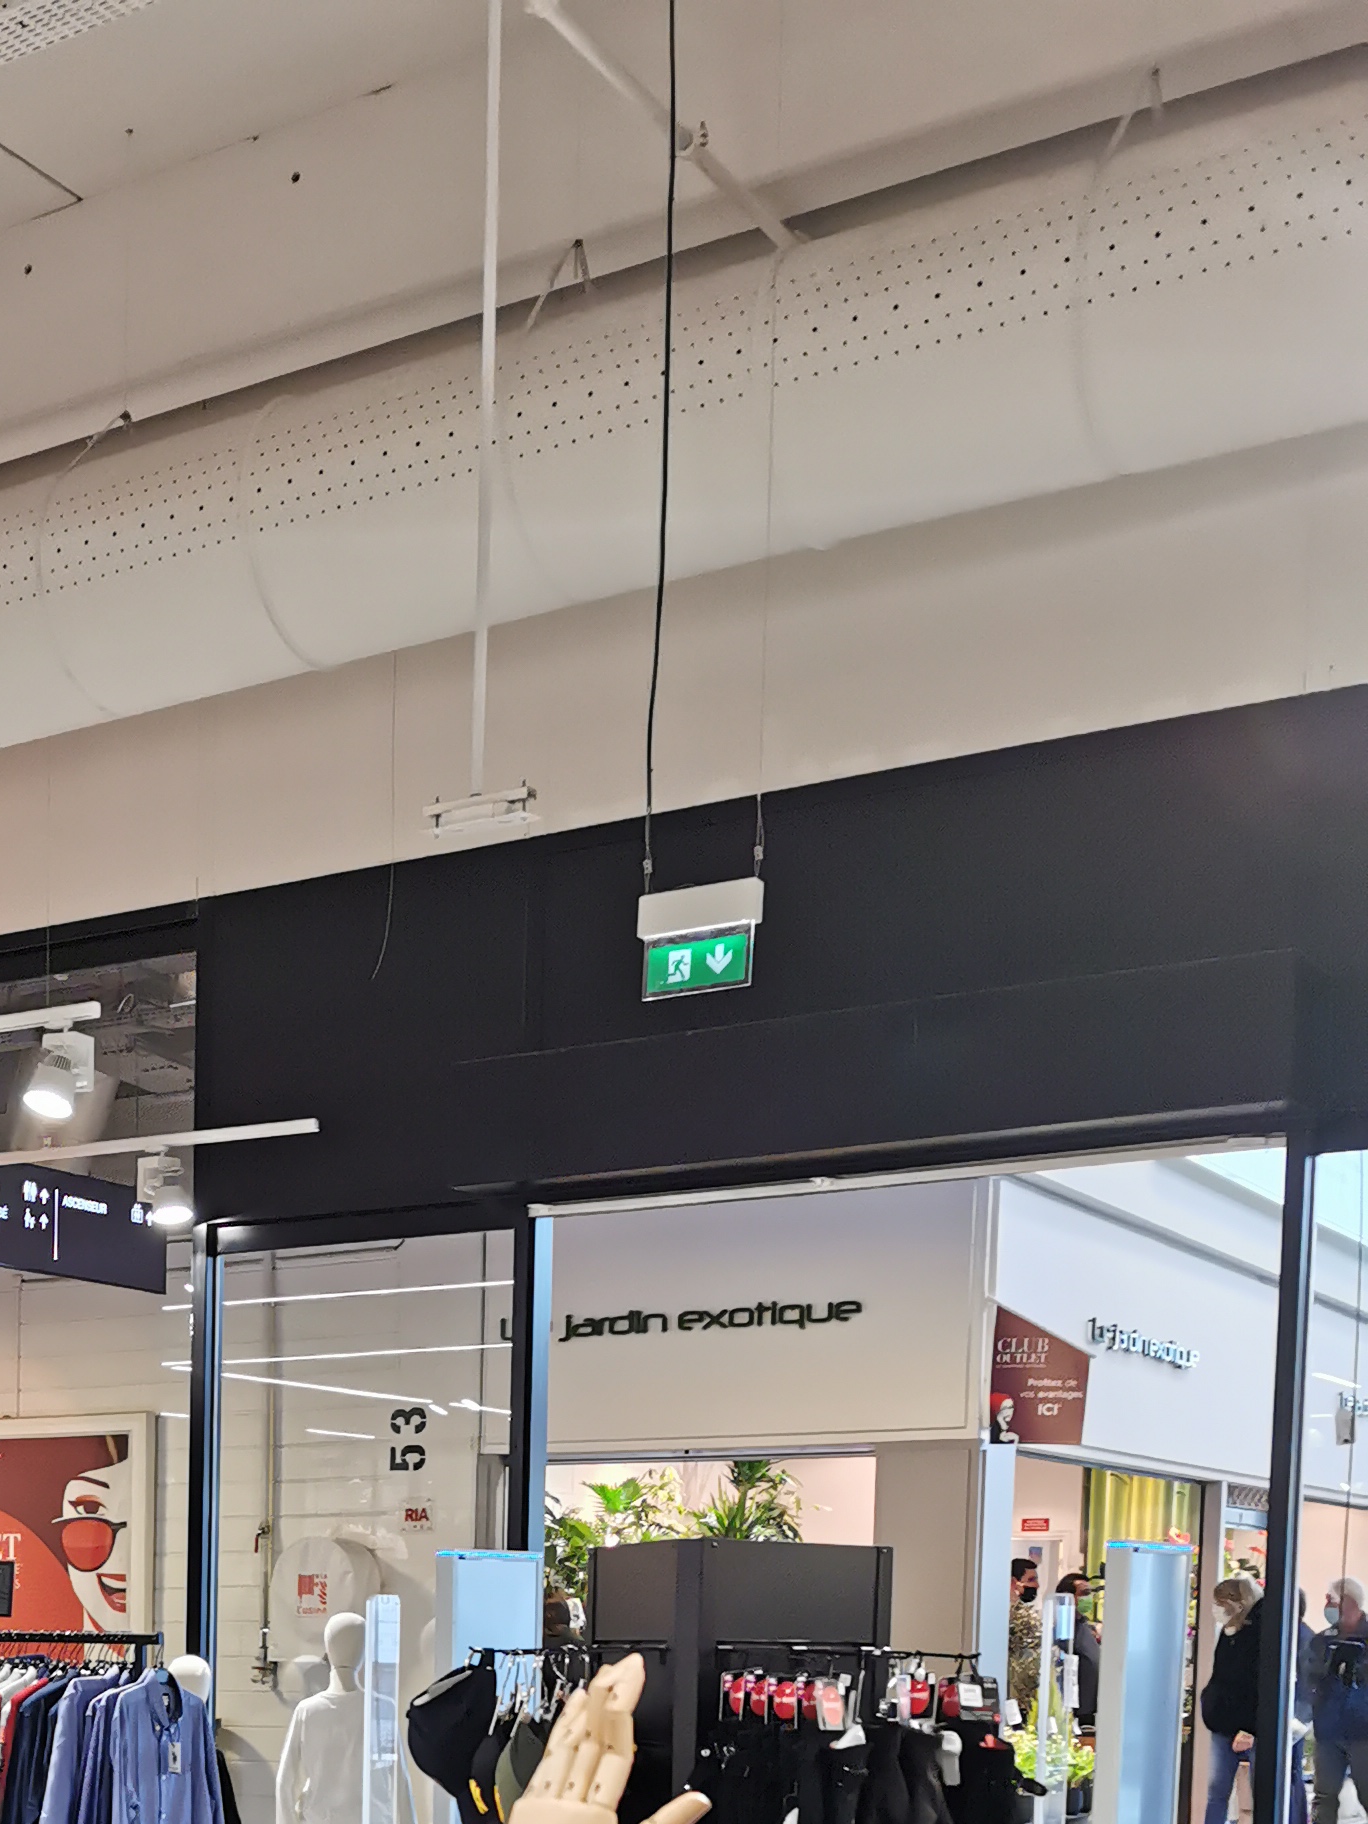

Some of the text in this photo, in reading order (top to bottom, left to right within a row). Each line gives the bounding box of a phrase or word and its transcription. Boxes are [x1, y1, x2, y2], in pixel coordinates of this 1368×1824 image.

[61, 1194, 108, 1215] ASCENSEUR
[558, 1310, 669, 1342] jardin
[677, 1300, 863, 1330] exotique
[997, 1337, 1049, 1353] CLUB
[404, 1508, 430, 1522] RIA
